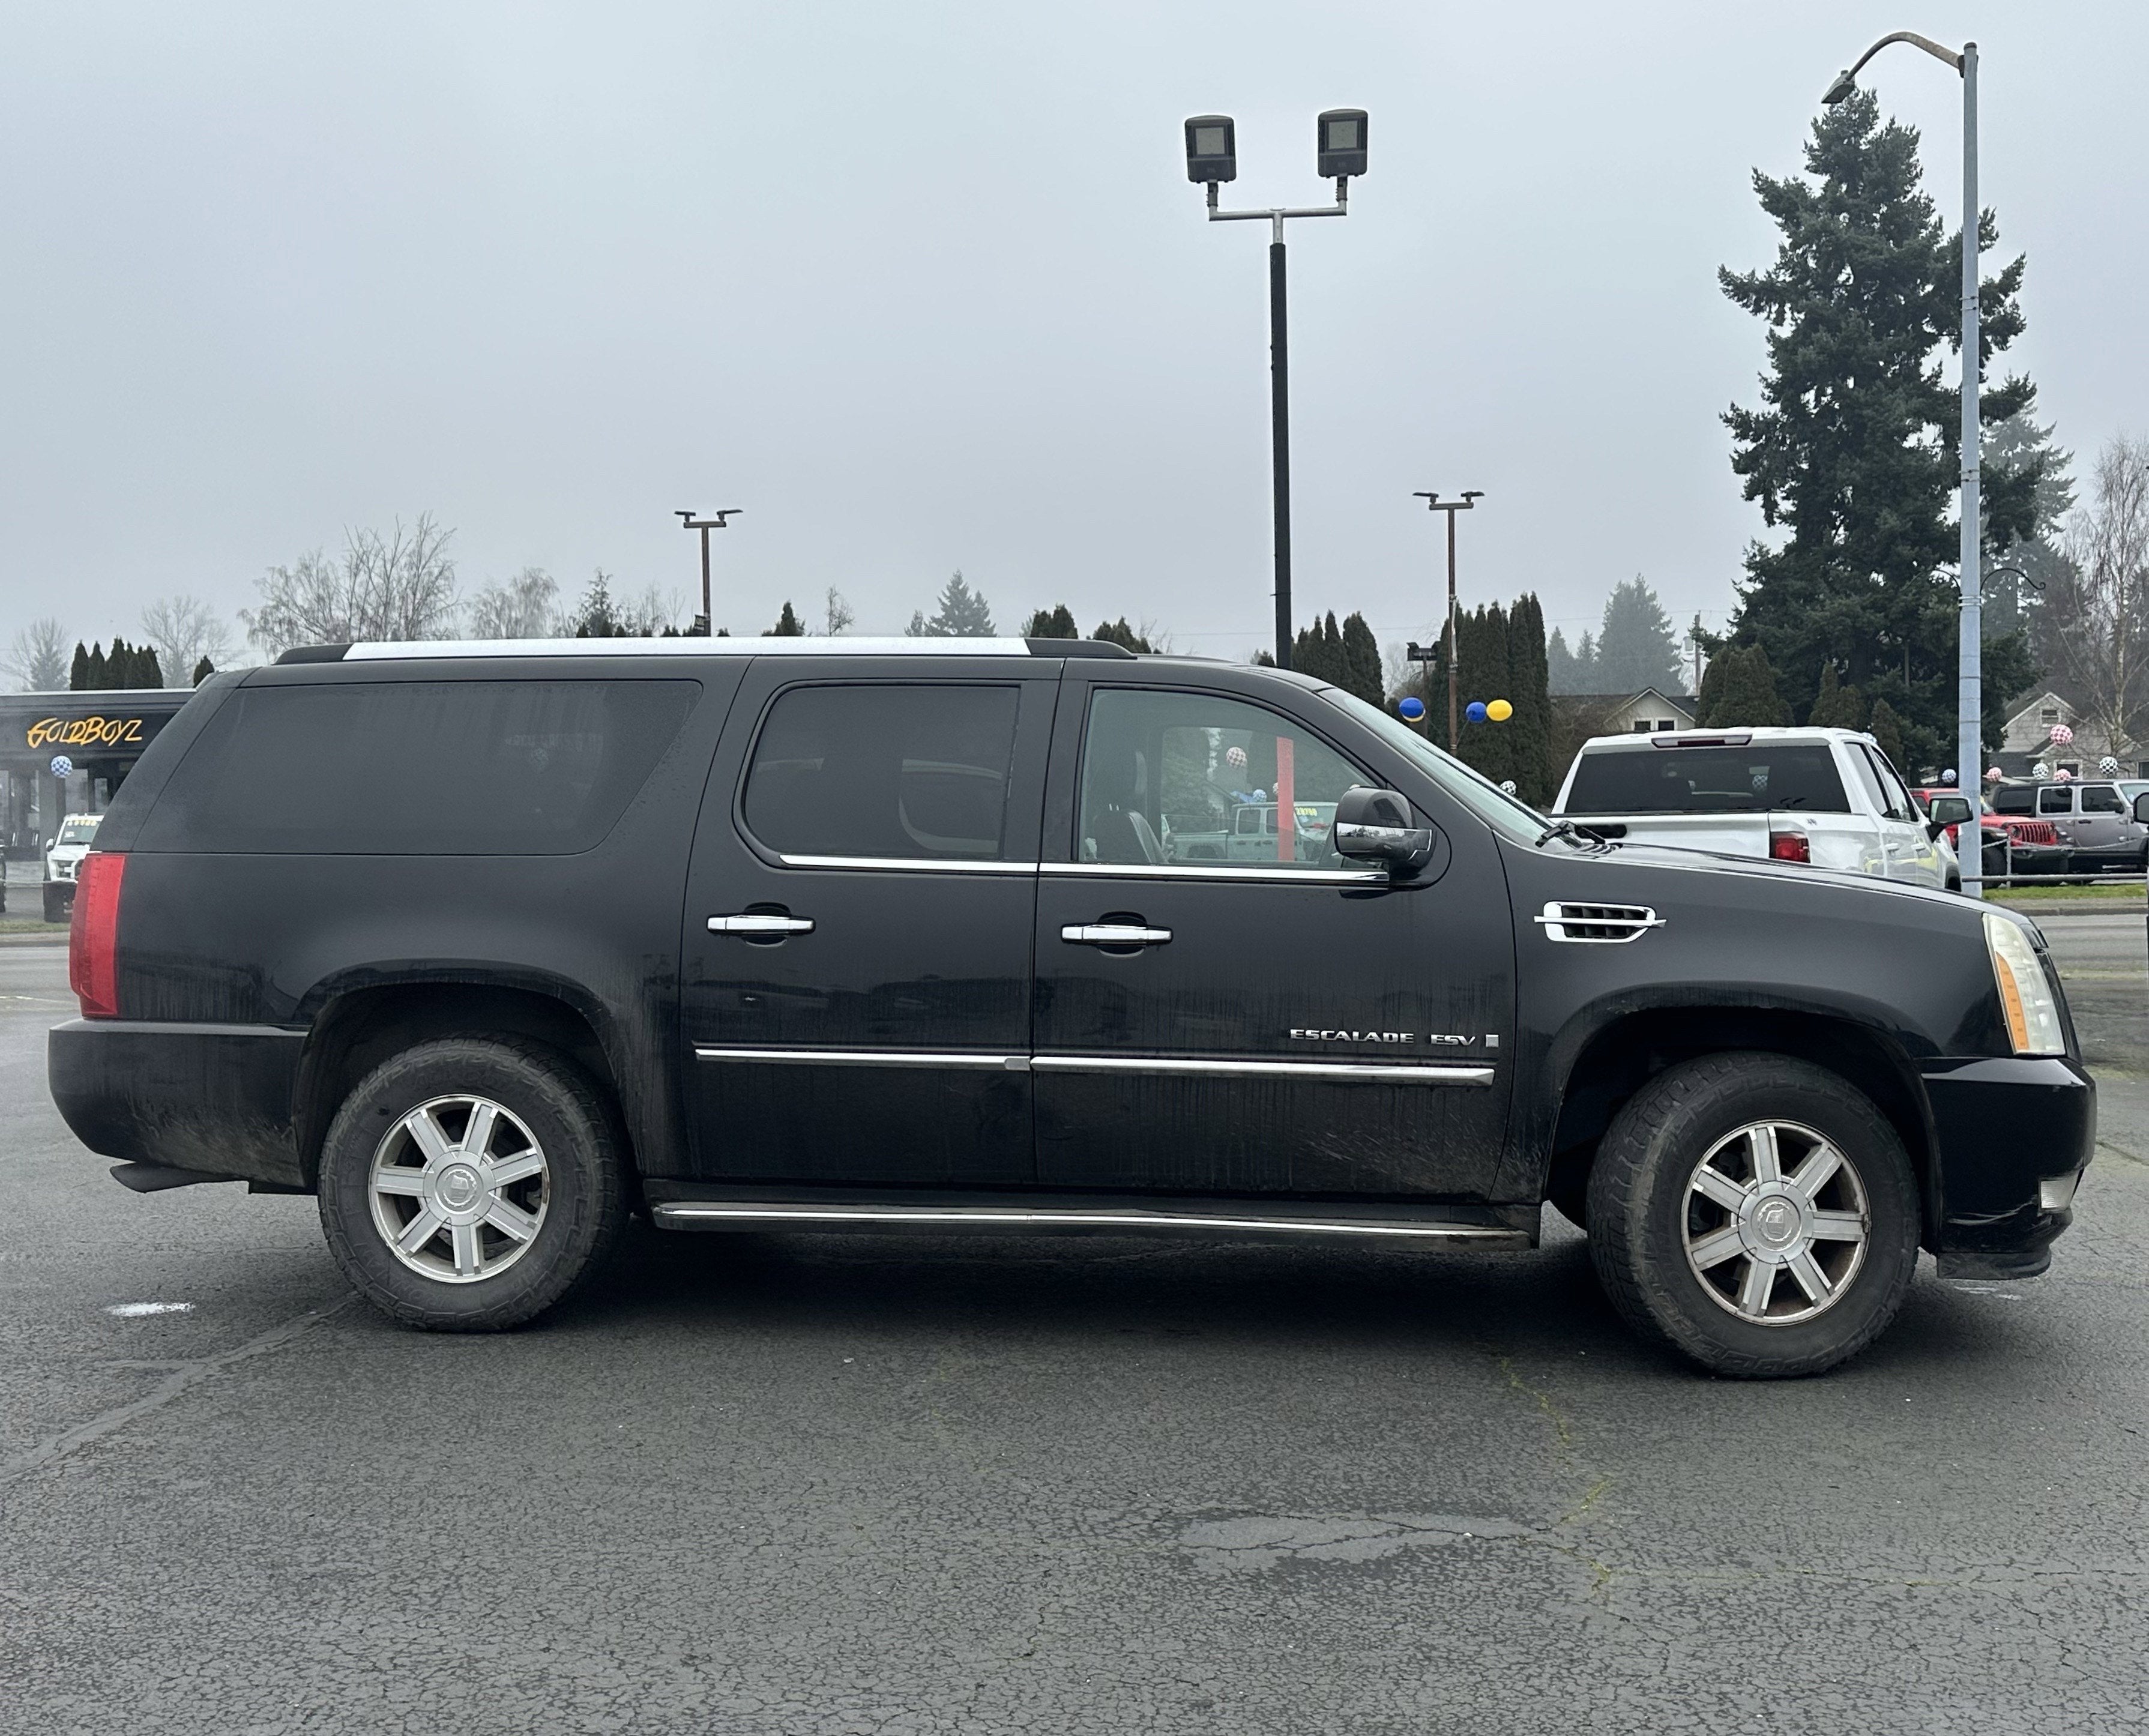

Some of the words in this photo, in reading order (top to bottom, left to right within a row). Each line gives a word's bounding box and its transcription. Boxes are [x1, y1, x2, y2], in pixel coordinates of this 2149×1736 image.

[27, 716, 143, 749] GOLDBOYZ
[1289, 1028, 1414, 1044] ESCALADE
[1430, 1034, 1476, 1046] ESV
